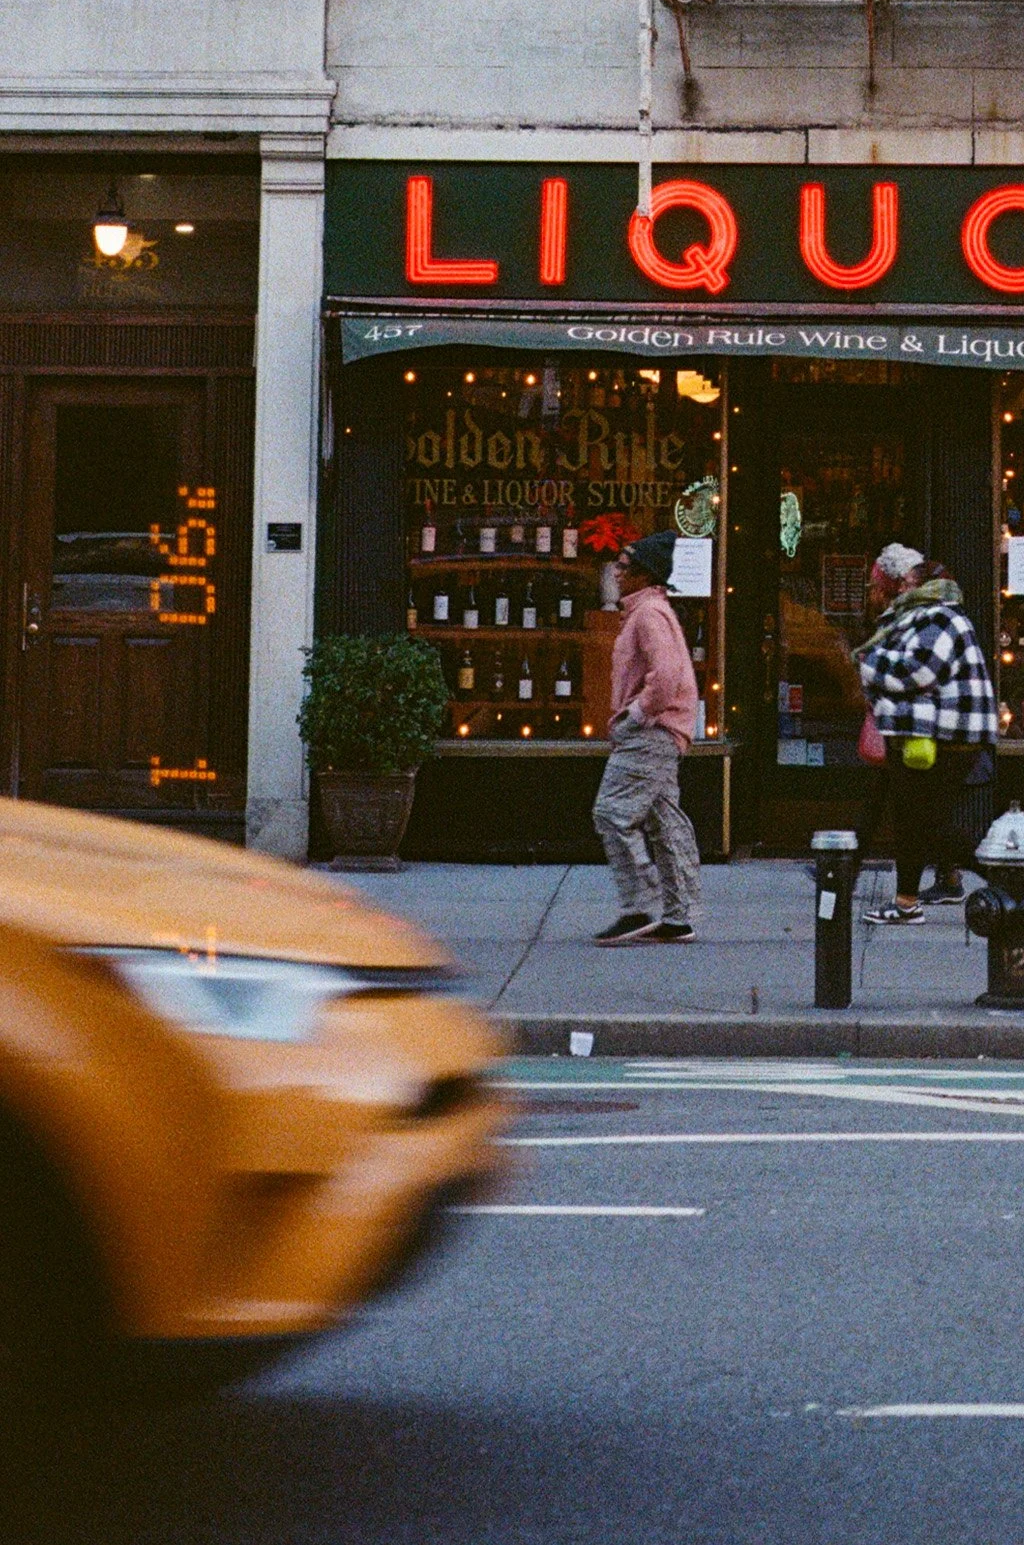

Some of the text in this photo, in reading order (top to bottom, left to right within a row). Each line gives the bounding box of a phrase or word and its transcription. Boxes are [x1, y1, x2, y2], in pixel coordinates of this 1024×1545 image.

[364, 324, 423, 341] 457
[567, 326, 694, 348] Golden
[707, 330, 786, 346] Rule
[799, 331, 887, 350] Wine
[900, 334, 924, 352] &
[555, 407, 687, 471] Rule
[408, 478, 457, 505] INE
[588, 480, 673, 507] STORE
